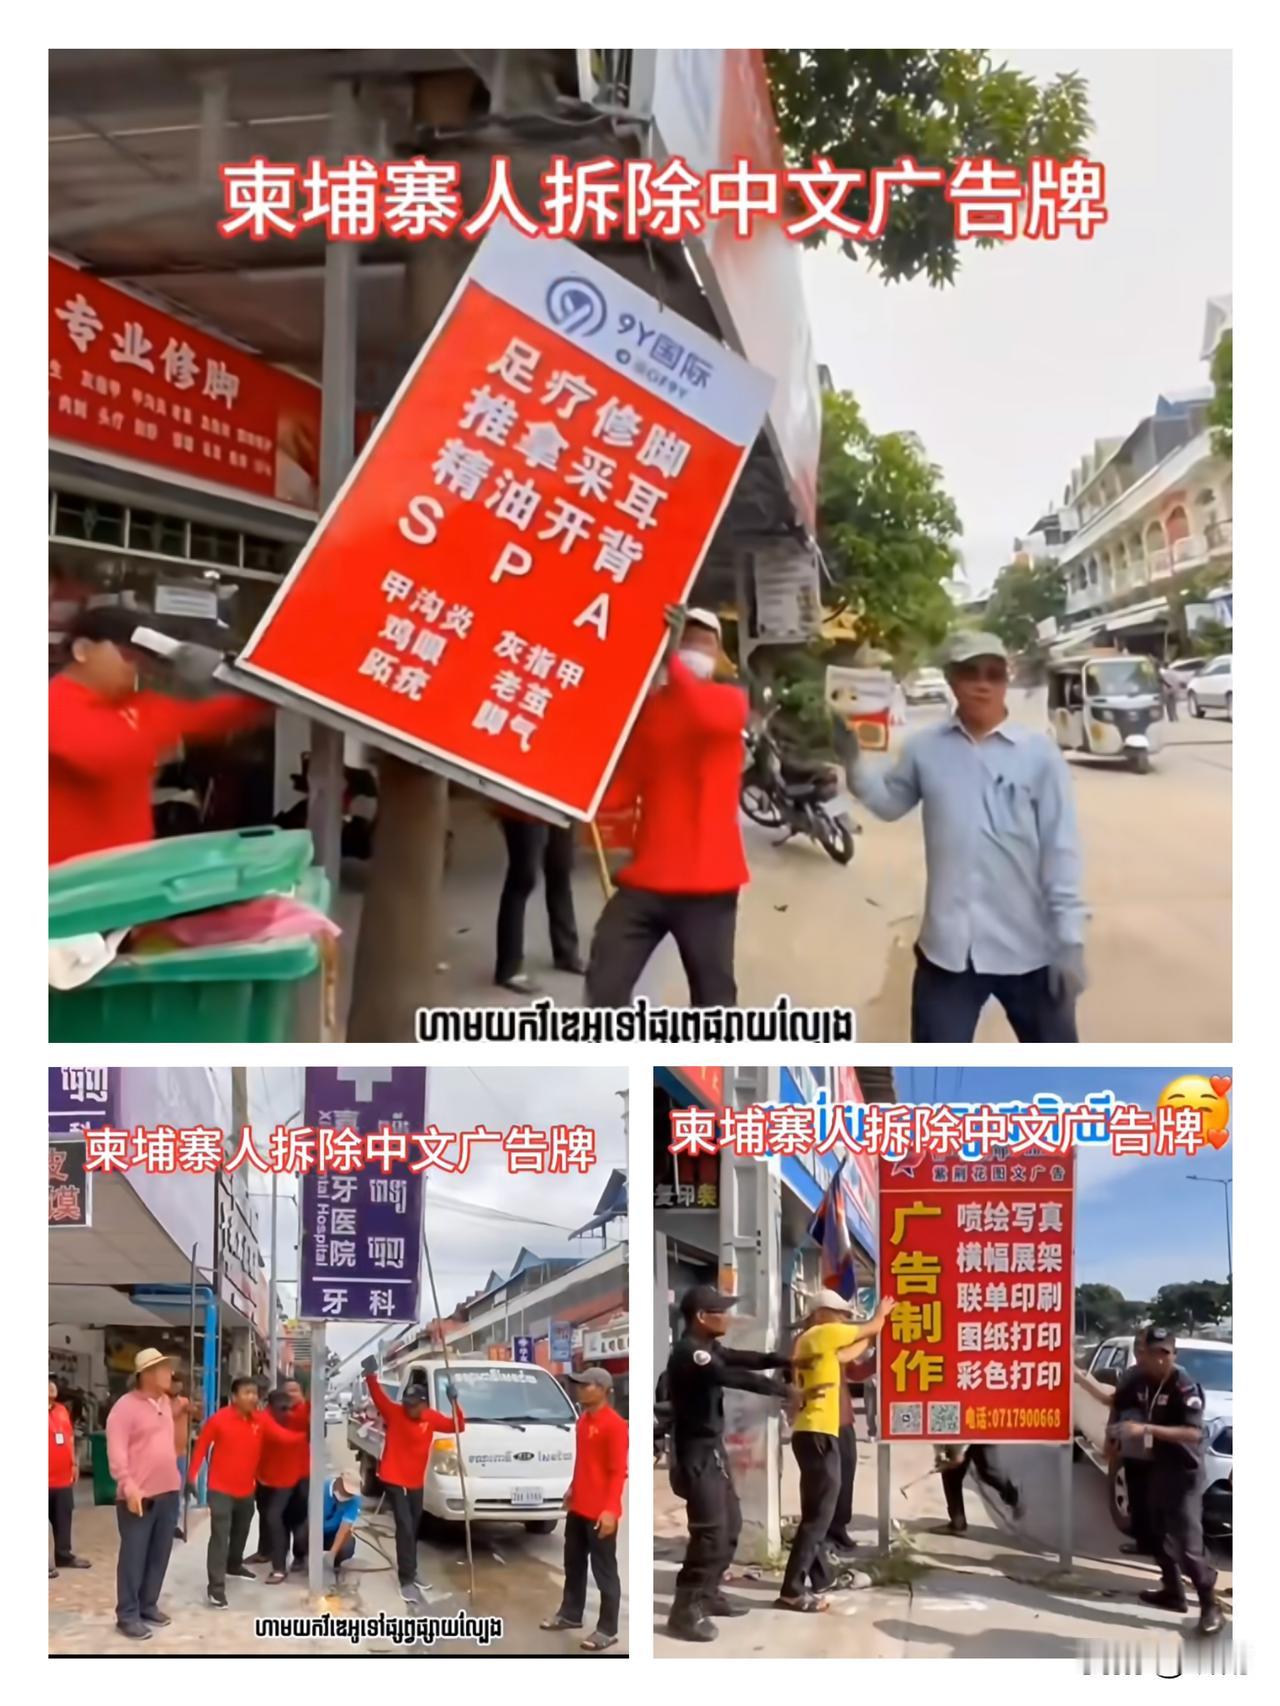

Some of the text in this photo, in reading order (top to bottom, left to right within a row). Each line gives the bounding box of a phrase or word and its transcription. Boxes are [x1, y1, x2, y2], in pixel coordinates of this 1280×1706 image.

[55, 293, 240, 410] 专业修脚
[617, 312, 715, 390] 9Y国际
[486, 337, 691, 478] 足疗修脚
[458, 384, 668, 530] 推拿采耳
[432, 437, 644, 584] 精油开背
[381, 569, 474, 640] 甲沟炎
[493, 630, 585, 690] 灰指甲
[932, 1164, 1066, 1183] 紫荆花图文广告
[313, 1203, 330, 1267] Hospital
[956, 1201, 1064, 1233] 喷绘写真
[956, 1241, 1063, 1273] 横幅展架
[321, 1287, 396, 1317] 牙科
[889, 1200, 945, 1393] 广告制作
[956, 1281, 1062, 1313] 联单印刷
[956, 1321, 1062, 1352] 图纸打印
[956, 1360, 1062, 1391] 彩色打印
